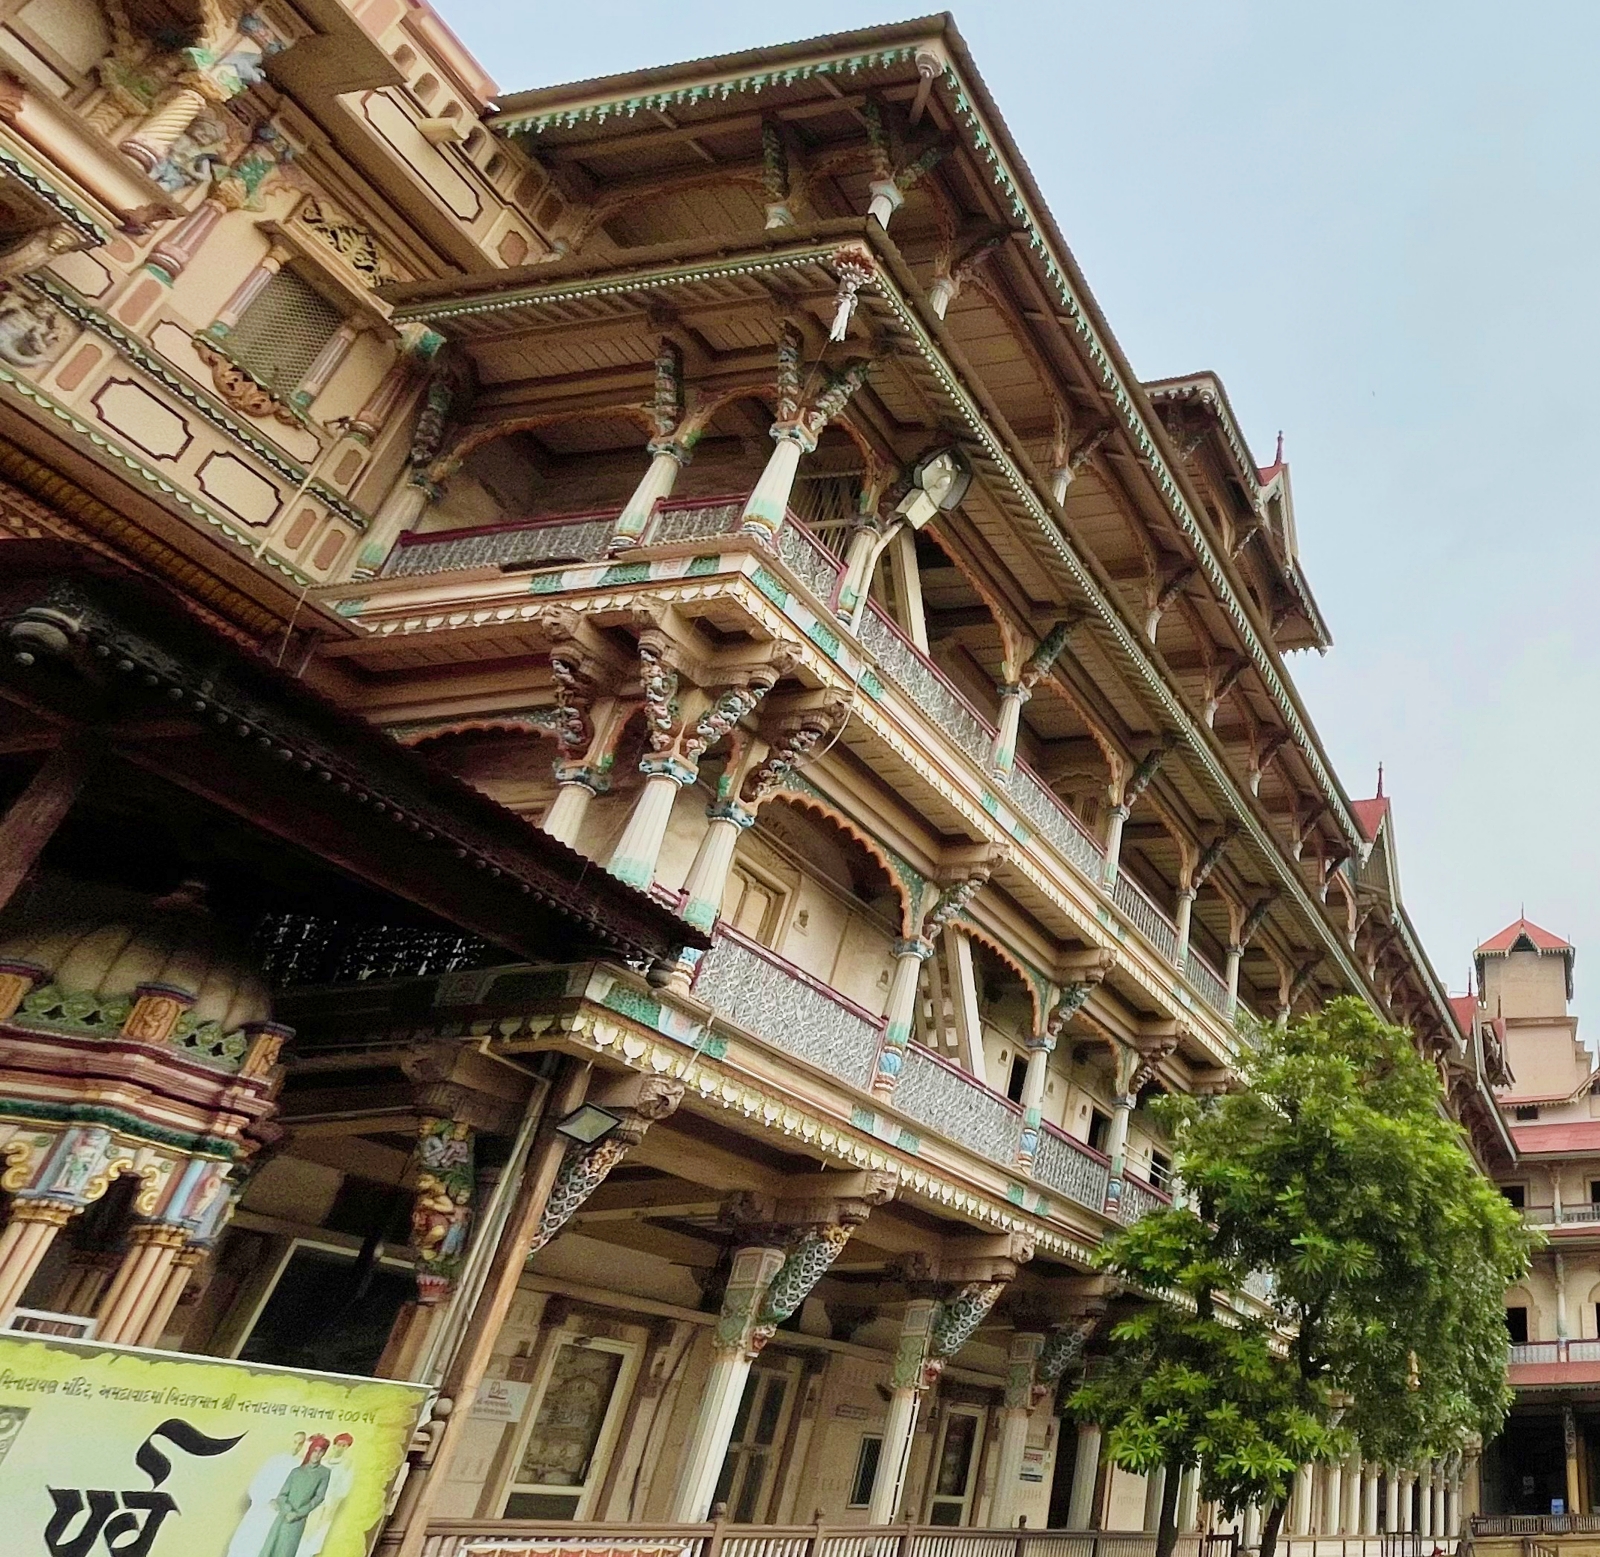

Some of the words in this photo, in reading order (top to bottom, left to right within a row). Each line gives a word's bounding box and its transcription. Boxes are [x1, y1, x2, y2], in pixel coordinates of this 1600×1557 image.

[221, 1393, 237, 1410] શ્રી
[238, 1400, 287, 1416] નરનારાયણ
[290, 1404, 335, 1420] ભગવાનના
